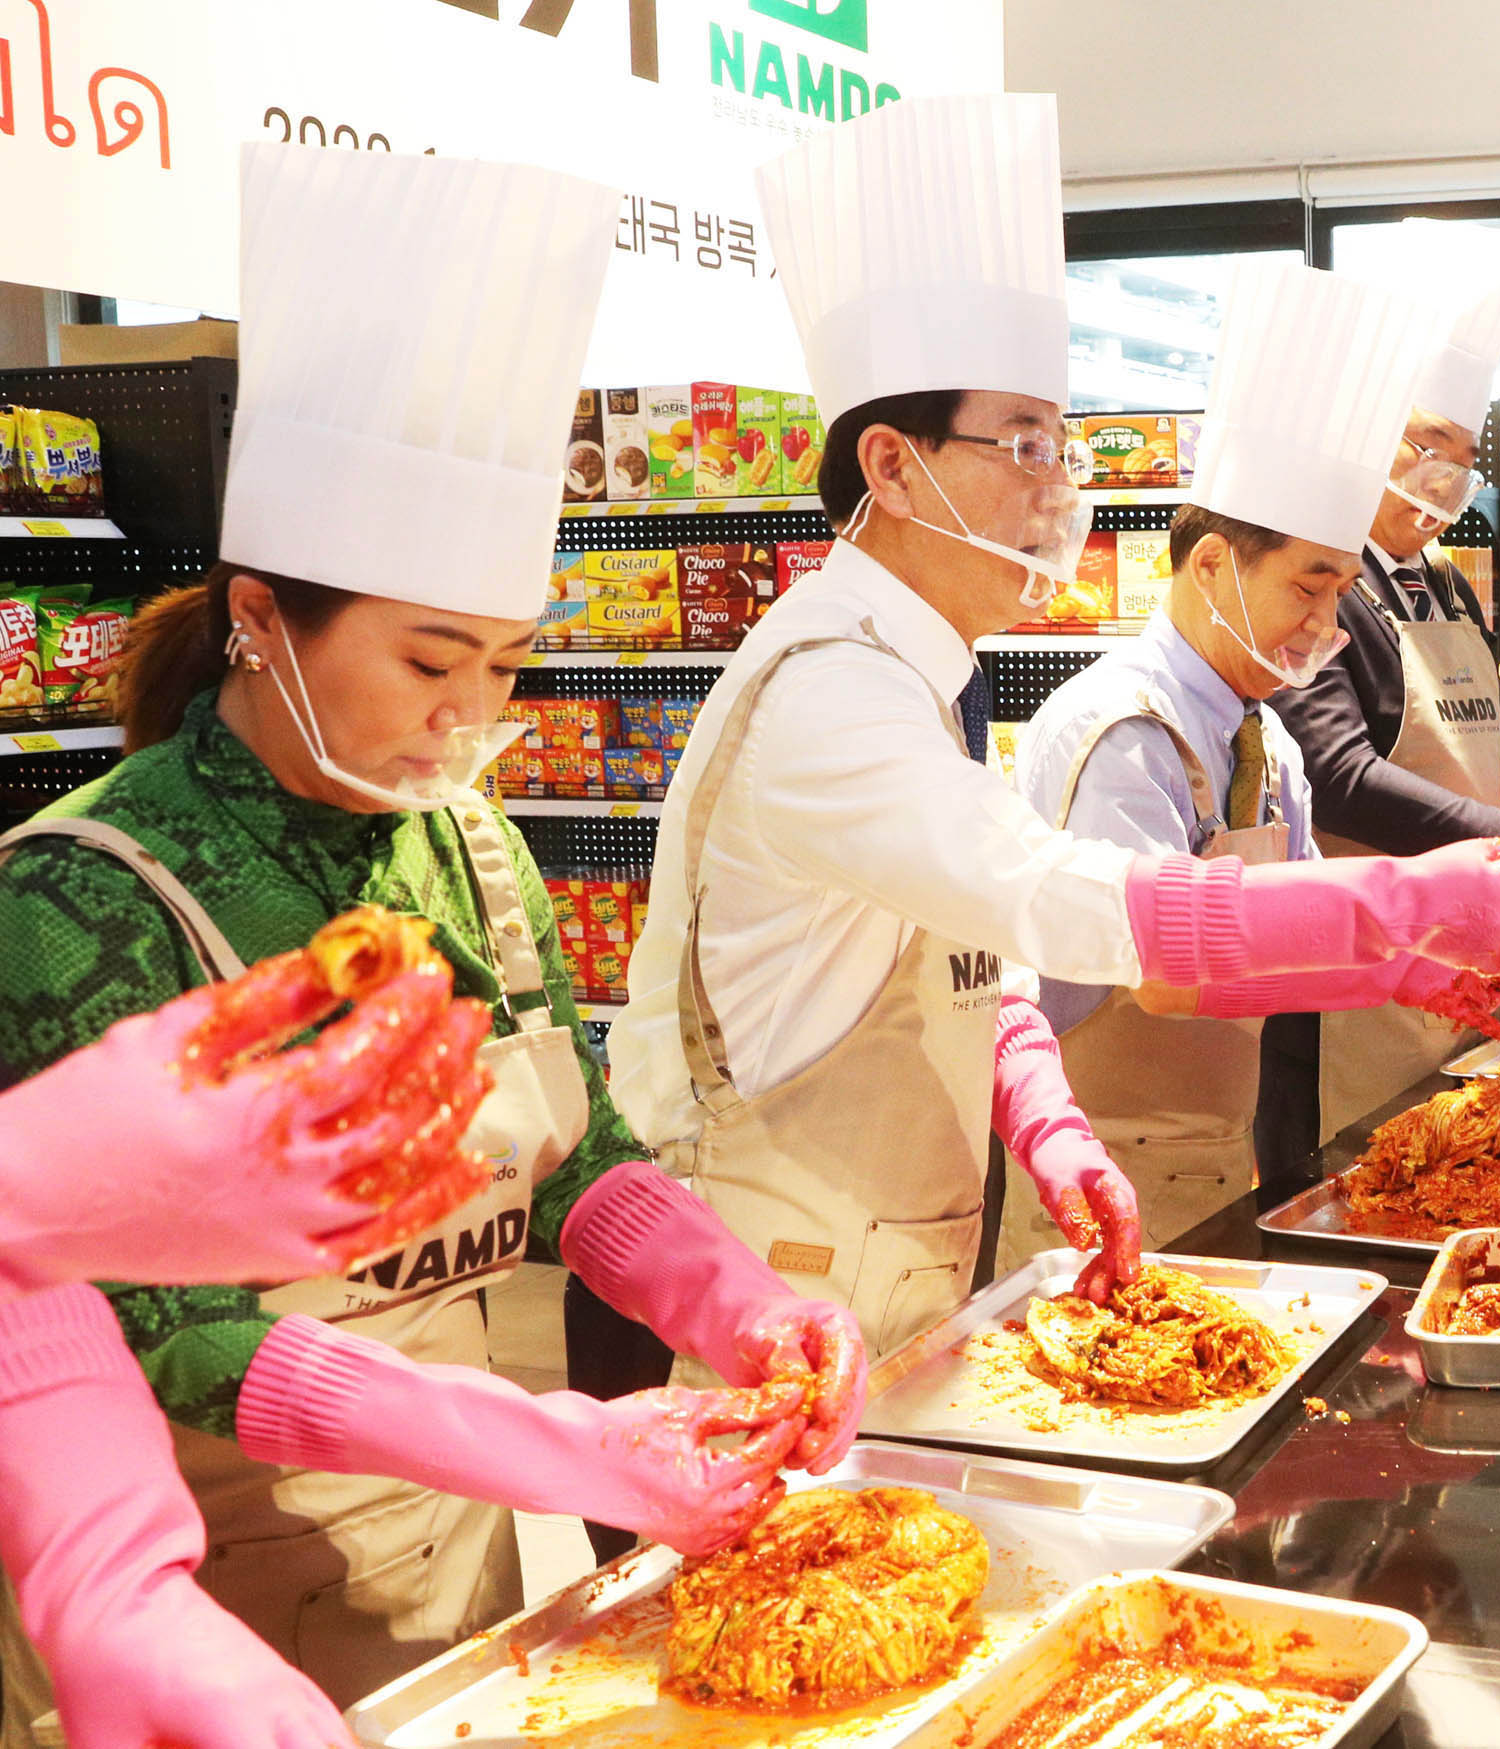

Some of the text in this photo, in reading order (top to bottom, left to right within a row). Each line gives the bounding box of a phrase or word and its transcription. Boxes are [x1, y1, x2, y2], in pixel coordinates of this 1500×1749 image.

[694, 211, 757, 278] 방콕
[1088, 434, 1145, 450] 마가렛트
[1122, 543, 1156, 560] 엄마손
[600, 554, 660, 571] Custard
[684, 555, 726, 570] Choco
[685, 571, 709, 586] Pie
[1124, 594, 1159, 610] 엄마손
[604, 605, 662, 622] Custard
[688, 609, 729, 623] Choco
[691, 624, 713, 639] Pie
[1435, 697, 1497, 722] NAMDO
[948, 950, 1001, 992] NAM
[953, 999, 971, 1012] THE
